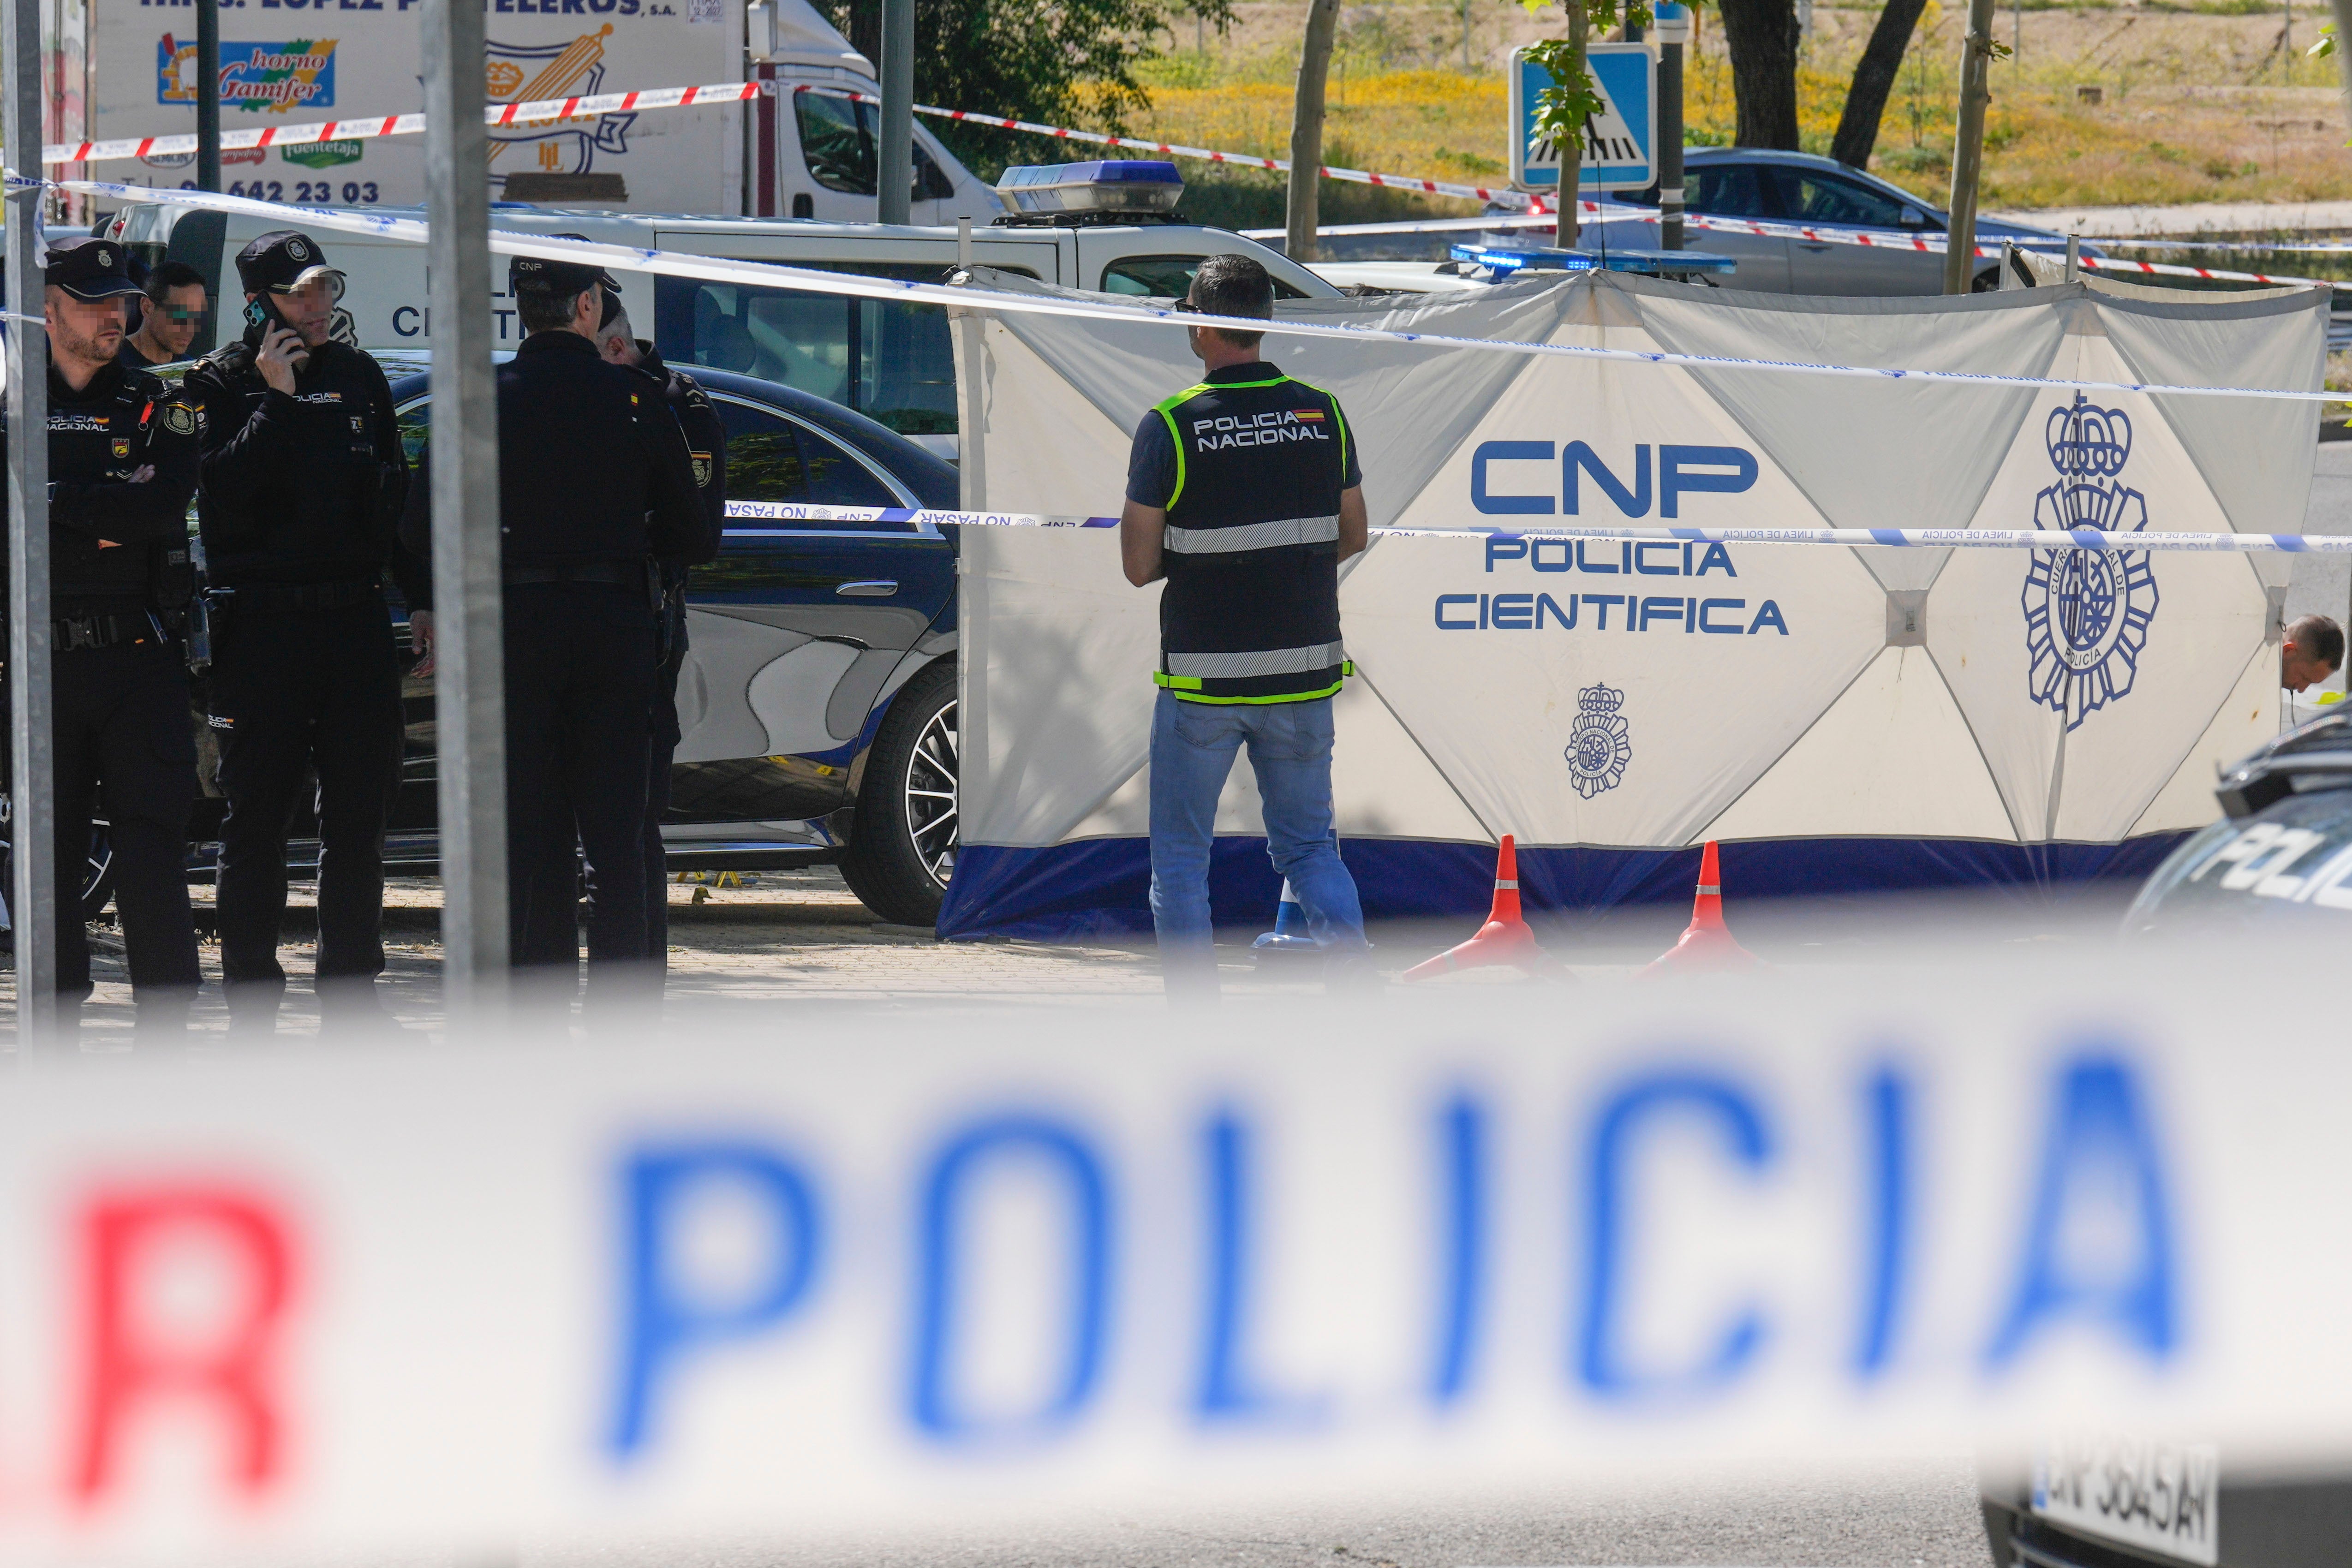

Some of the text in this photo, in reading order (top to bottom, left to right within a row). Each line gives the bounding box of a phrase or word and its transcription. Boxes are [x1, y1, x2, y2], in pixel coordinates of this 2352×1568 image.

[251, 48, 327, 70] horno
[228, 180, 379, 203] 642 23 03
[519, 262, 543, 271] CNP
[293, 392, 331, 402] OLICIA
[1197, 426, 1329, 453] NACIONAL
[1471, 439, 1759, 519] CNP
[781, 507, 806, 519] NO
[921, 513, 979, 525] PASAR
[985, 516, 1011, 526] NO
[1485, 537, 1738, 578] POLICIA
[1435, 592, 1789, 635] CIENTIFICA
[1589, 729, 1612, 744] NACIONAL
[1610, 744, 1615, 753] DE
[595, 1049, 2189, 1467] POLICIA
